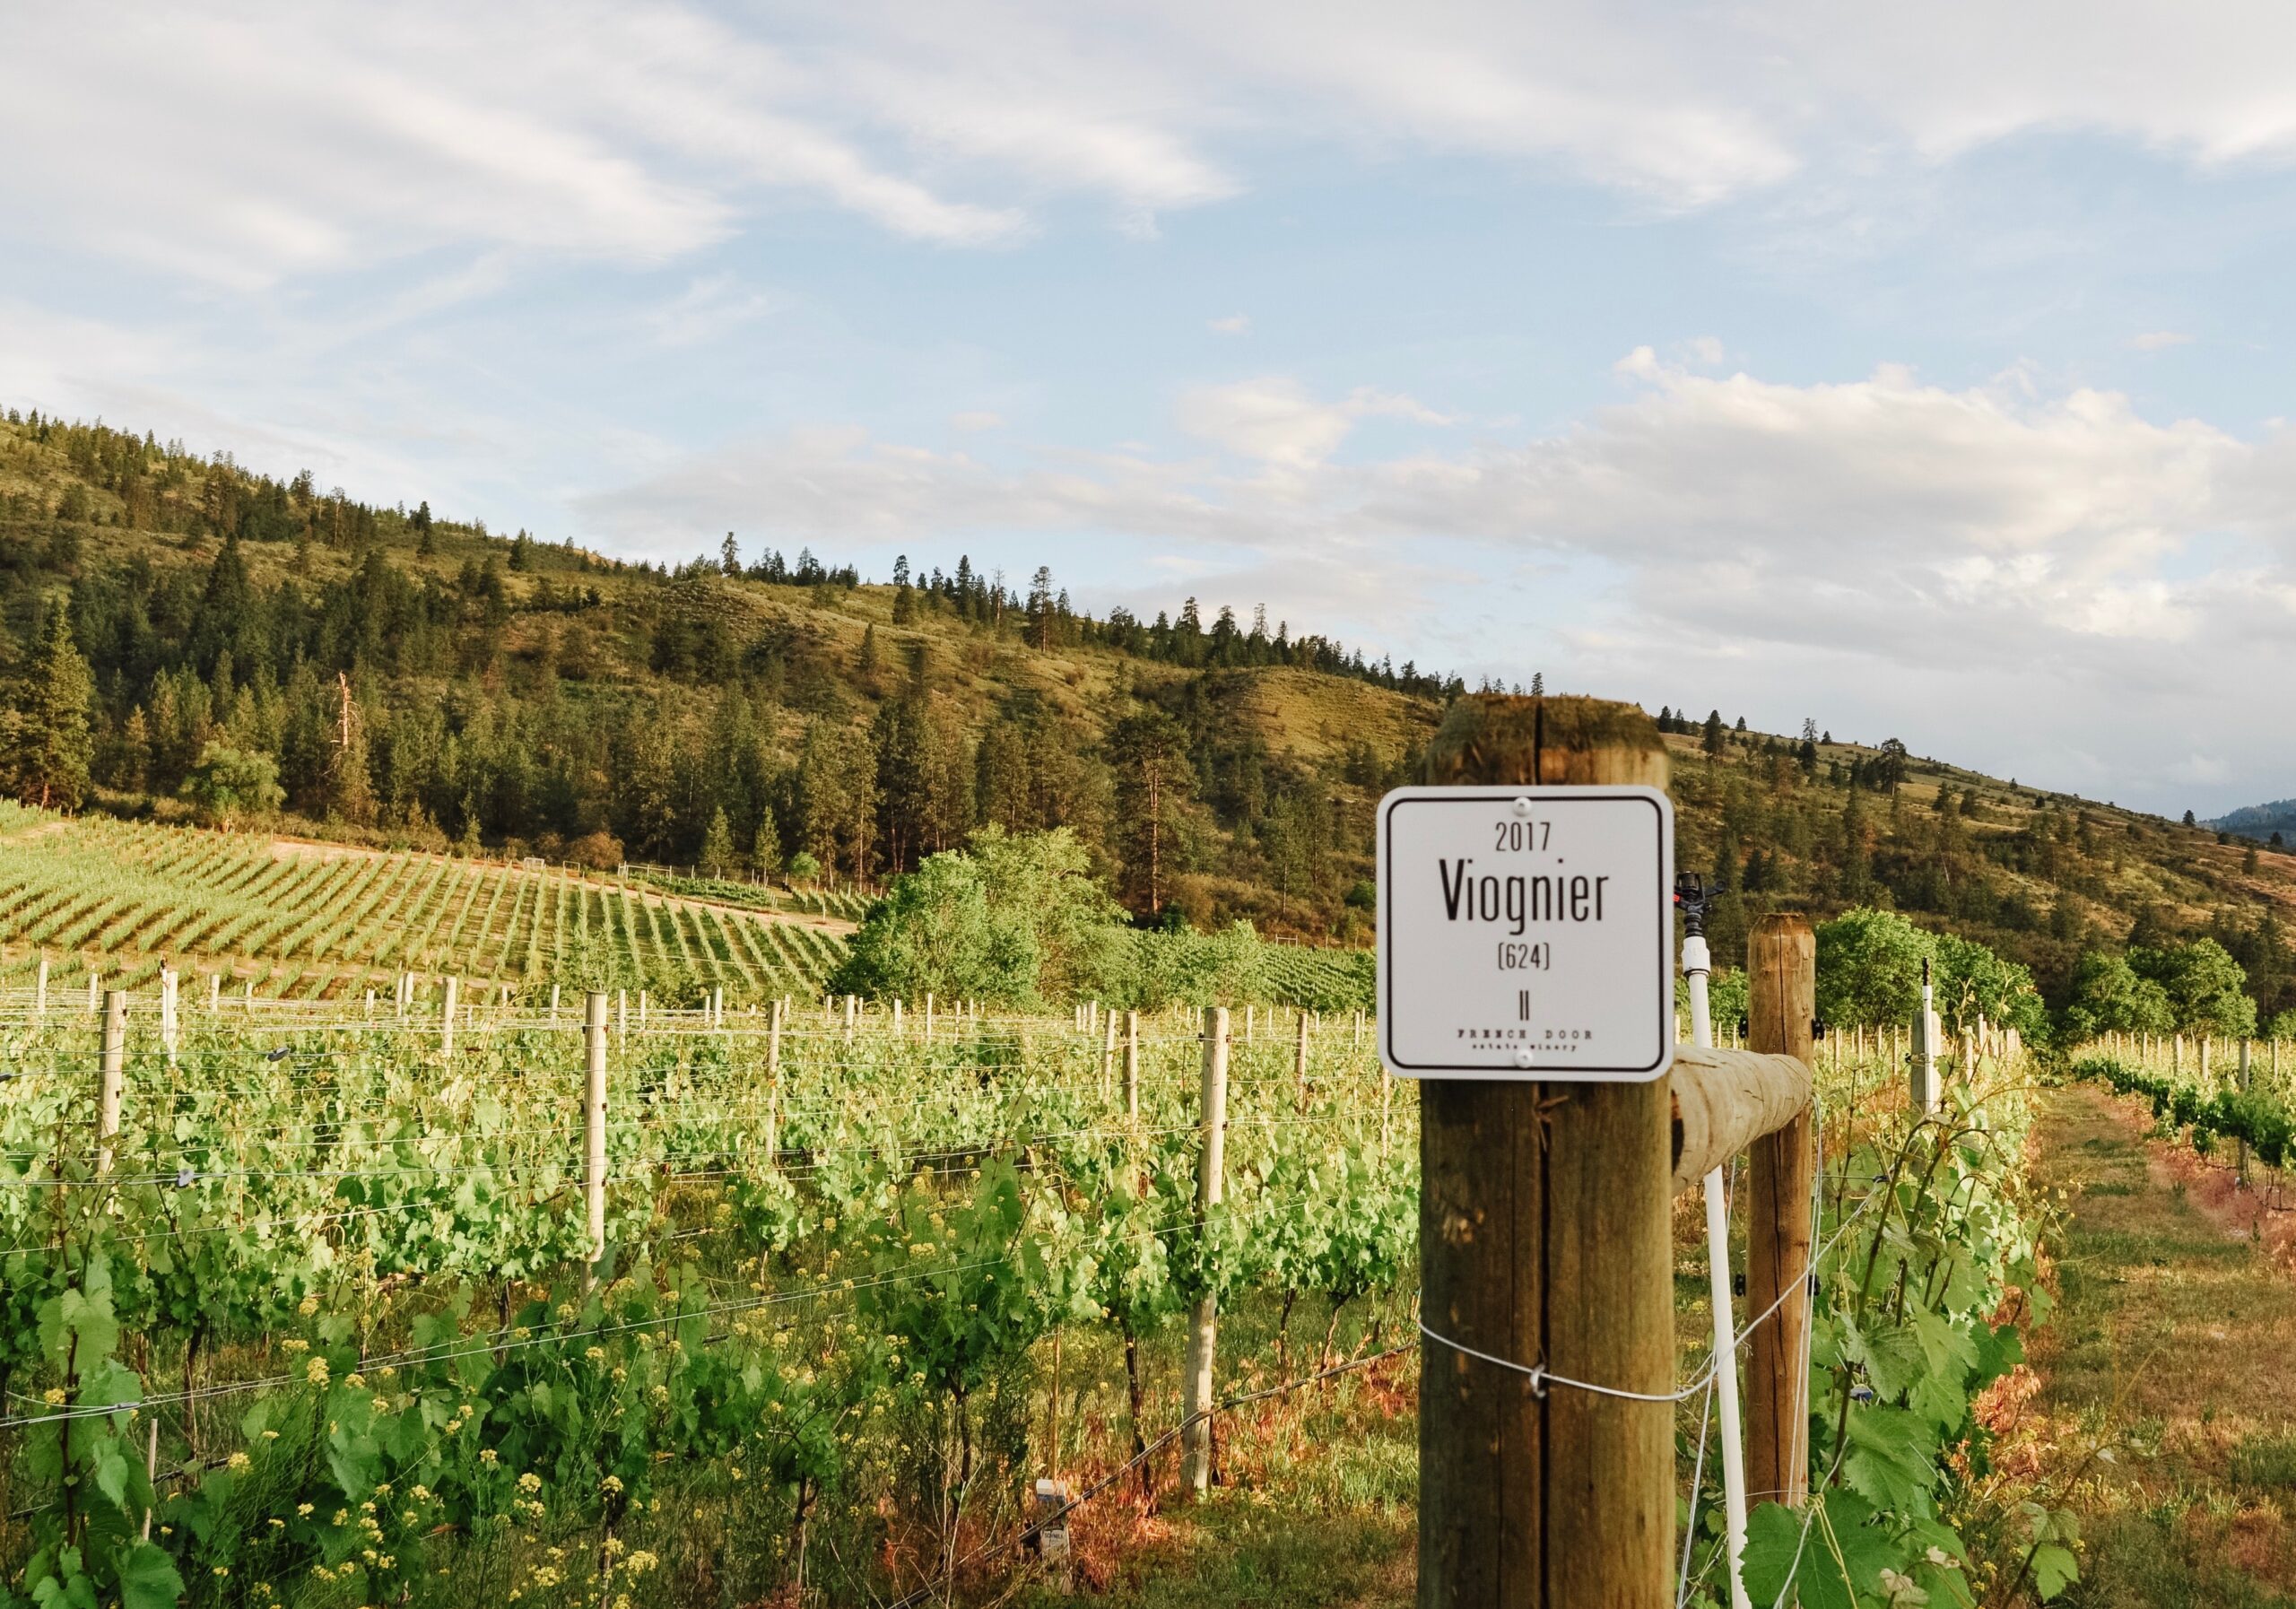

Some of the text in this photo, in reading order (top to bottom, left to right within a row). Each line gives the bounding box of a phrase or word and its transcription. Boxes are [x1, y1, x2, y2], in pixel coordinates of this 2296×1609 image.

[1495, 822, 1552, 852] 2017
[1439, 858, 1610, 936] Viognier
[1457, 1029, 1592, 1040] FRENCH DOOR
